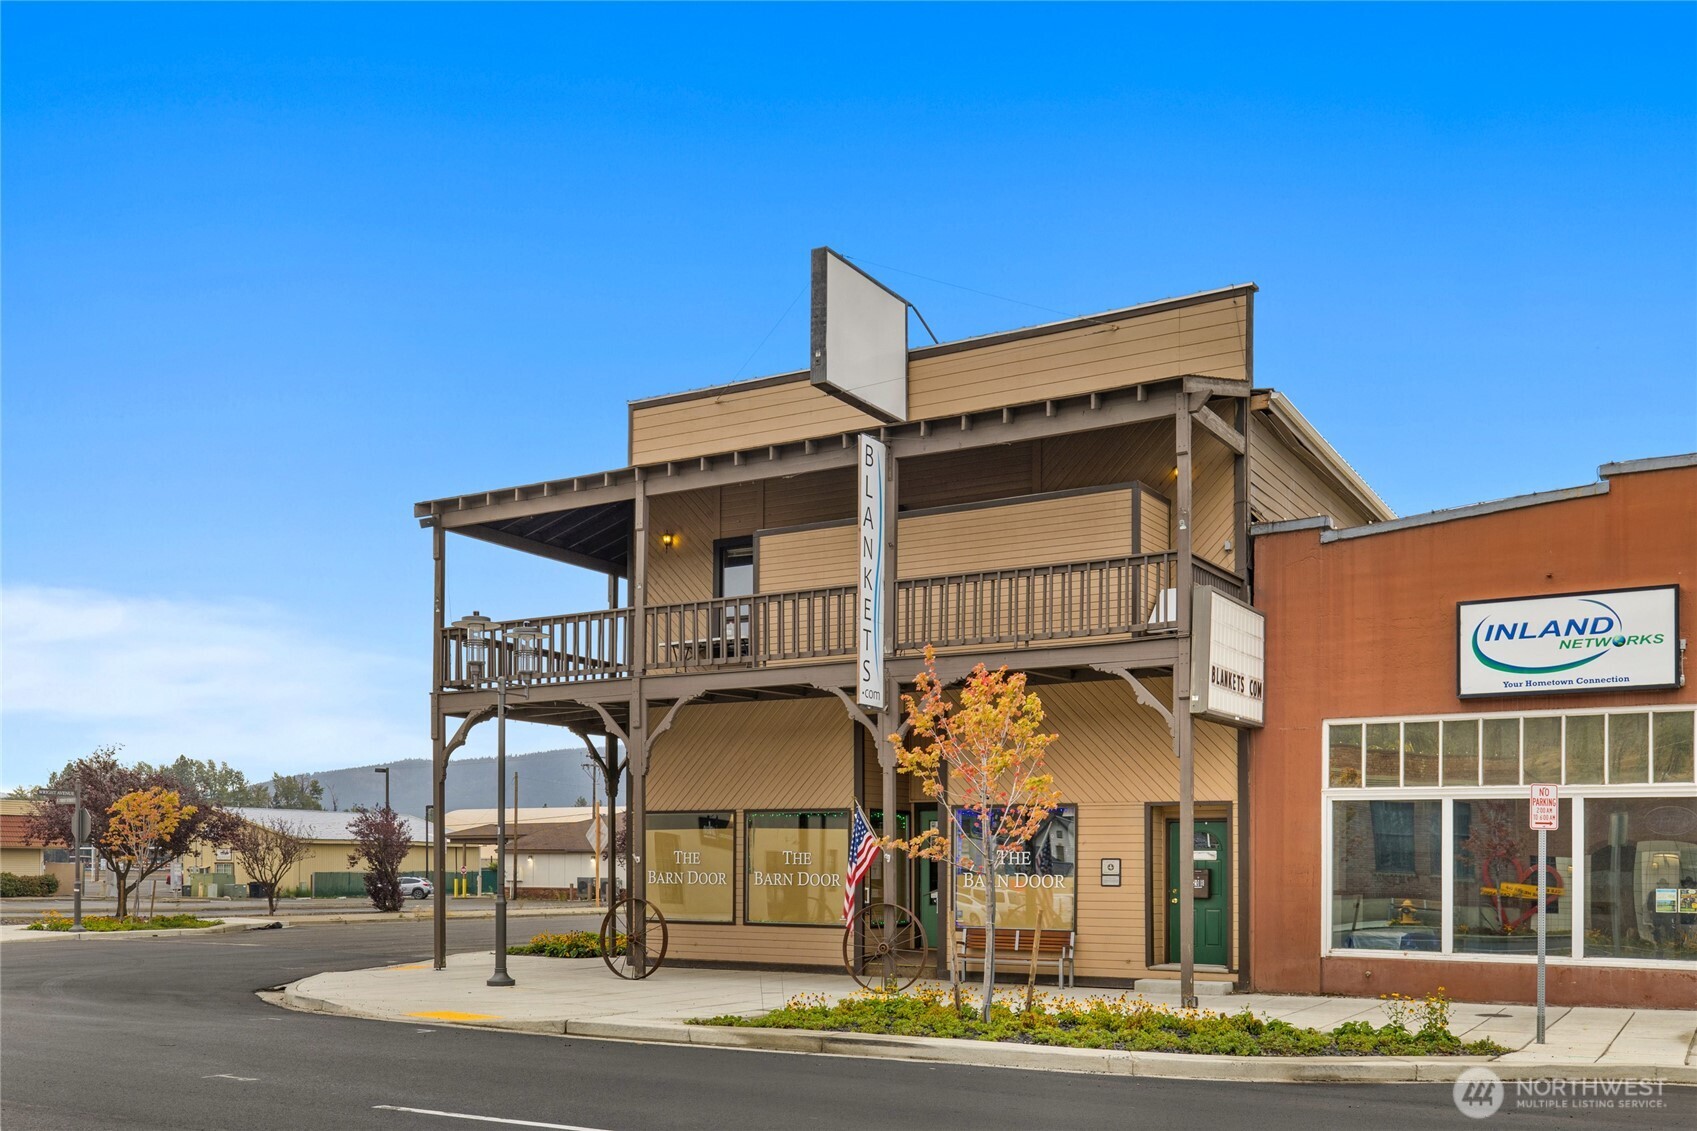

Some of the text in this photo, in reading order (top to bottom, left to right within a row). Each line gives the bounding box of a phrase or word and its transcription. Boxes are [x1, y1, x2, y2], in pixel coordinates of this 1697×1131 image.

[863, 444, 874, 683] BLANKETS
[1484, 616, 1614, 642] INLAND
[1559, 633, 1665, 650] NETWORKS
[1211, 665, 1245, 693] BLANKETS
[1503, 676, 1630, 688] Your Hometown Connection
[1539, 787, 1550, 796] NO
[1533, 798, 1556, 806] PARKING
[673, 850, 701, 865] THE
[782, 850, 812, 865] THE
[996, 849, 1032, 866] THE
[648, 870, 727, 885] BARN DOOR
[753, 871, 841, 887] BARN DOOR
[963, 872, 1066, 889] BAN DOOR
